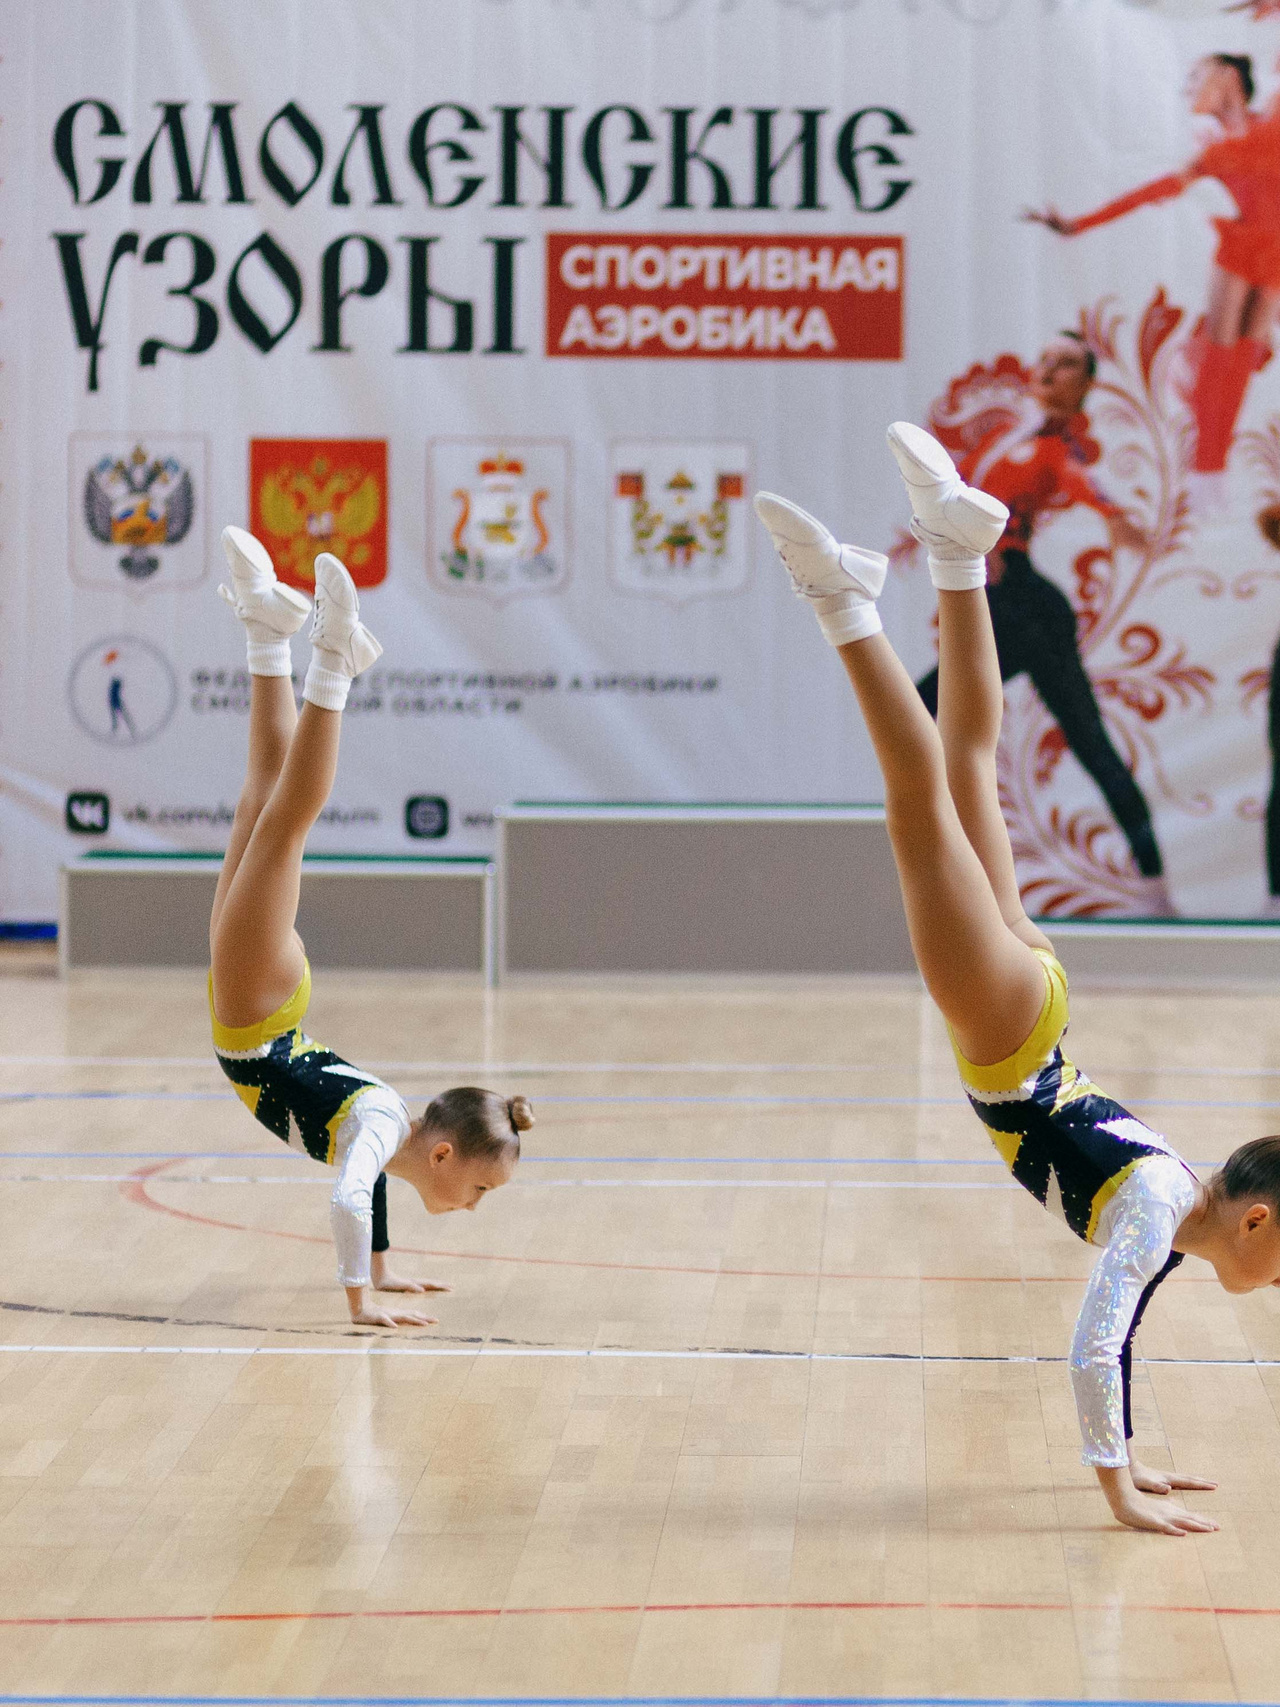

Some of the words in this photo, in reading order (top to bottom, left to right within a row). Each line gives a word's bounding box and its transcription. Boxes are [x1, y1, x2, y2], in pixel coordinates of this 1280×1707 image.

[52, 98, 915, 214] СМОЛЕНСКИЕ
[560, 245, 899, 290] СПОРТИВНАЯ
[51, 230, 526, 392] УЗОРЫ
[560, 305, 836, 350] АЭРОБИКА
